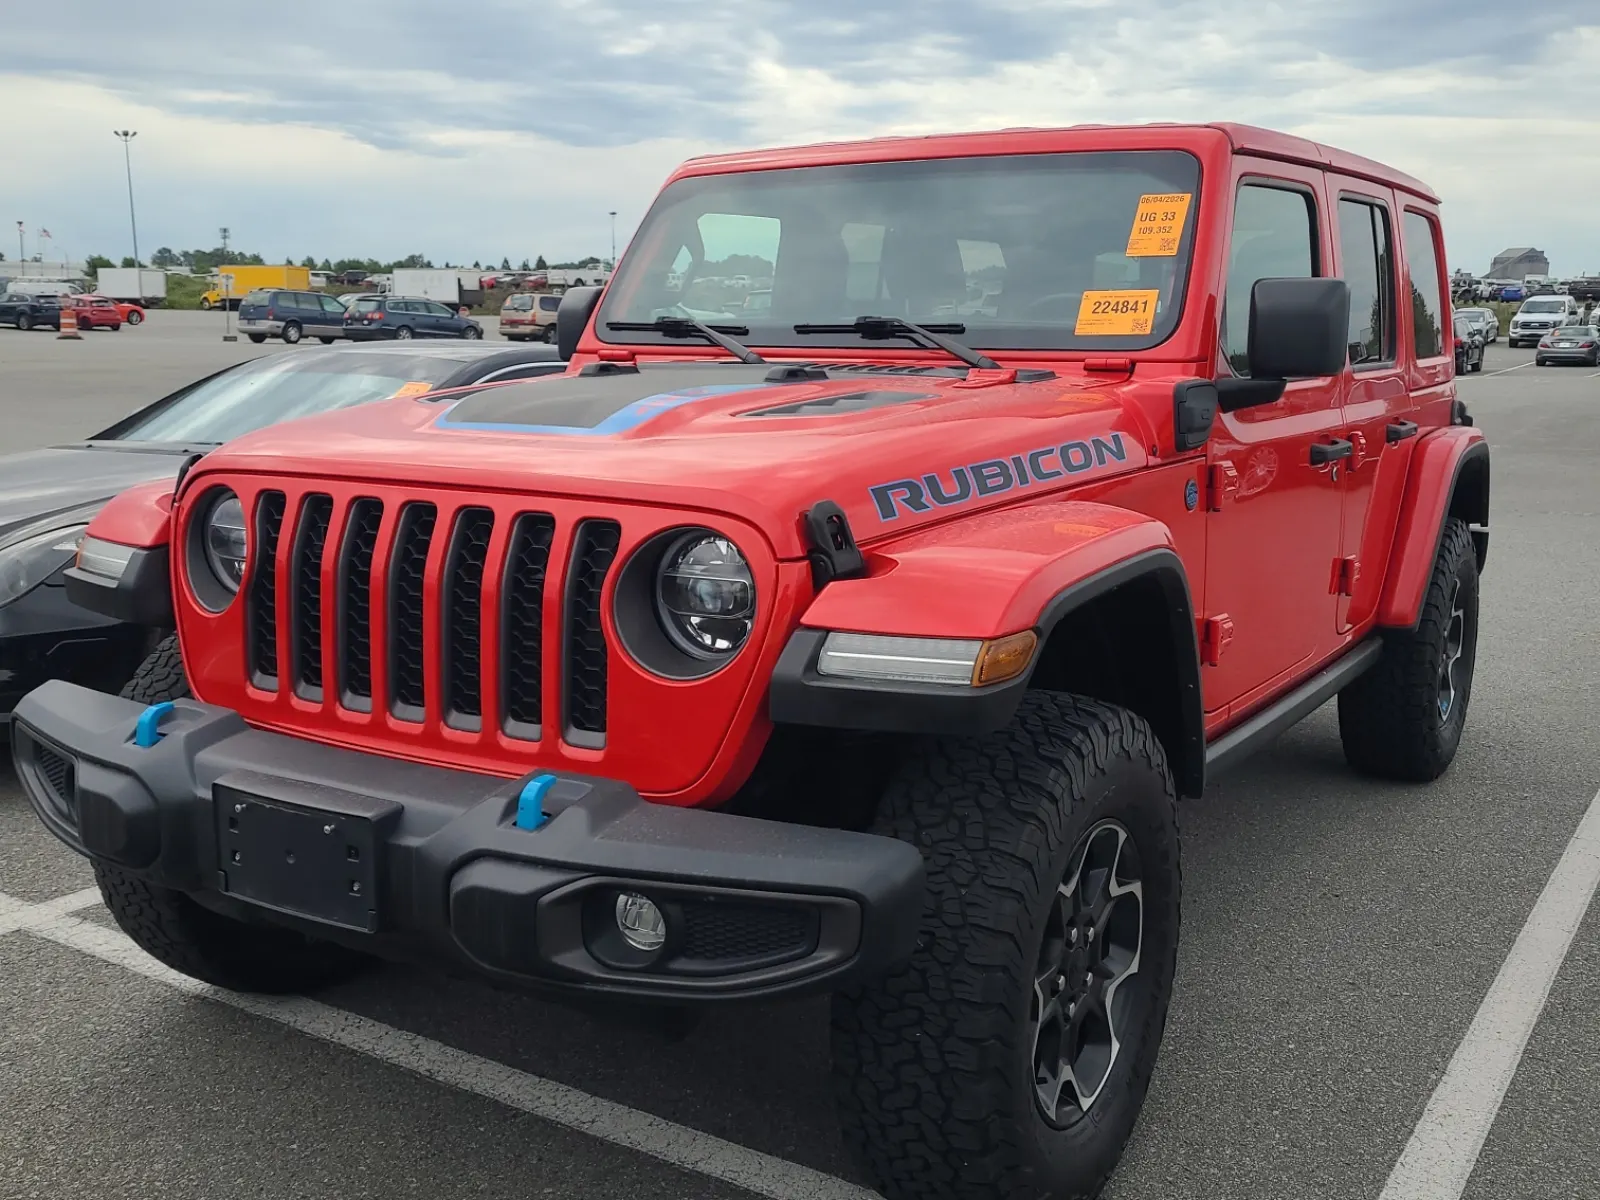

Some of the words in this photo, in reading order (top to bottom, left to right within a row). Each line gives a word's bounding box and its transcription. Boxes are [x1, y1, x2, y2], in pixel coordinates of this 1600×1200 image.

[1140, 212, 1157, 222] UG
[1161, 211, 1176, 221] 33
[1138, 226, 1173, 234] 109.352
[1091, 300, 1148, 314] 224841
[868, 431, 1128, 522] RUBICON
